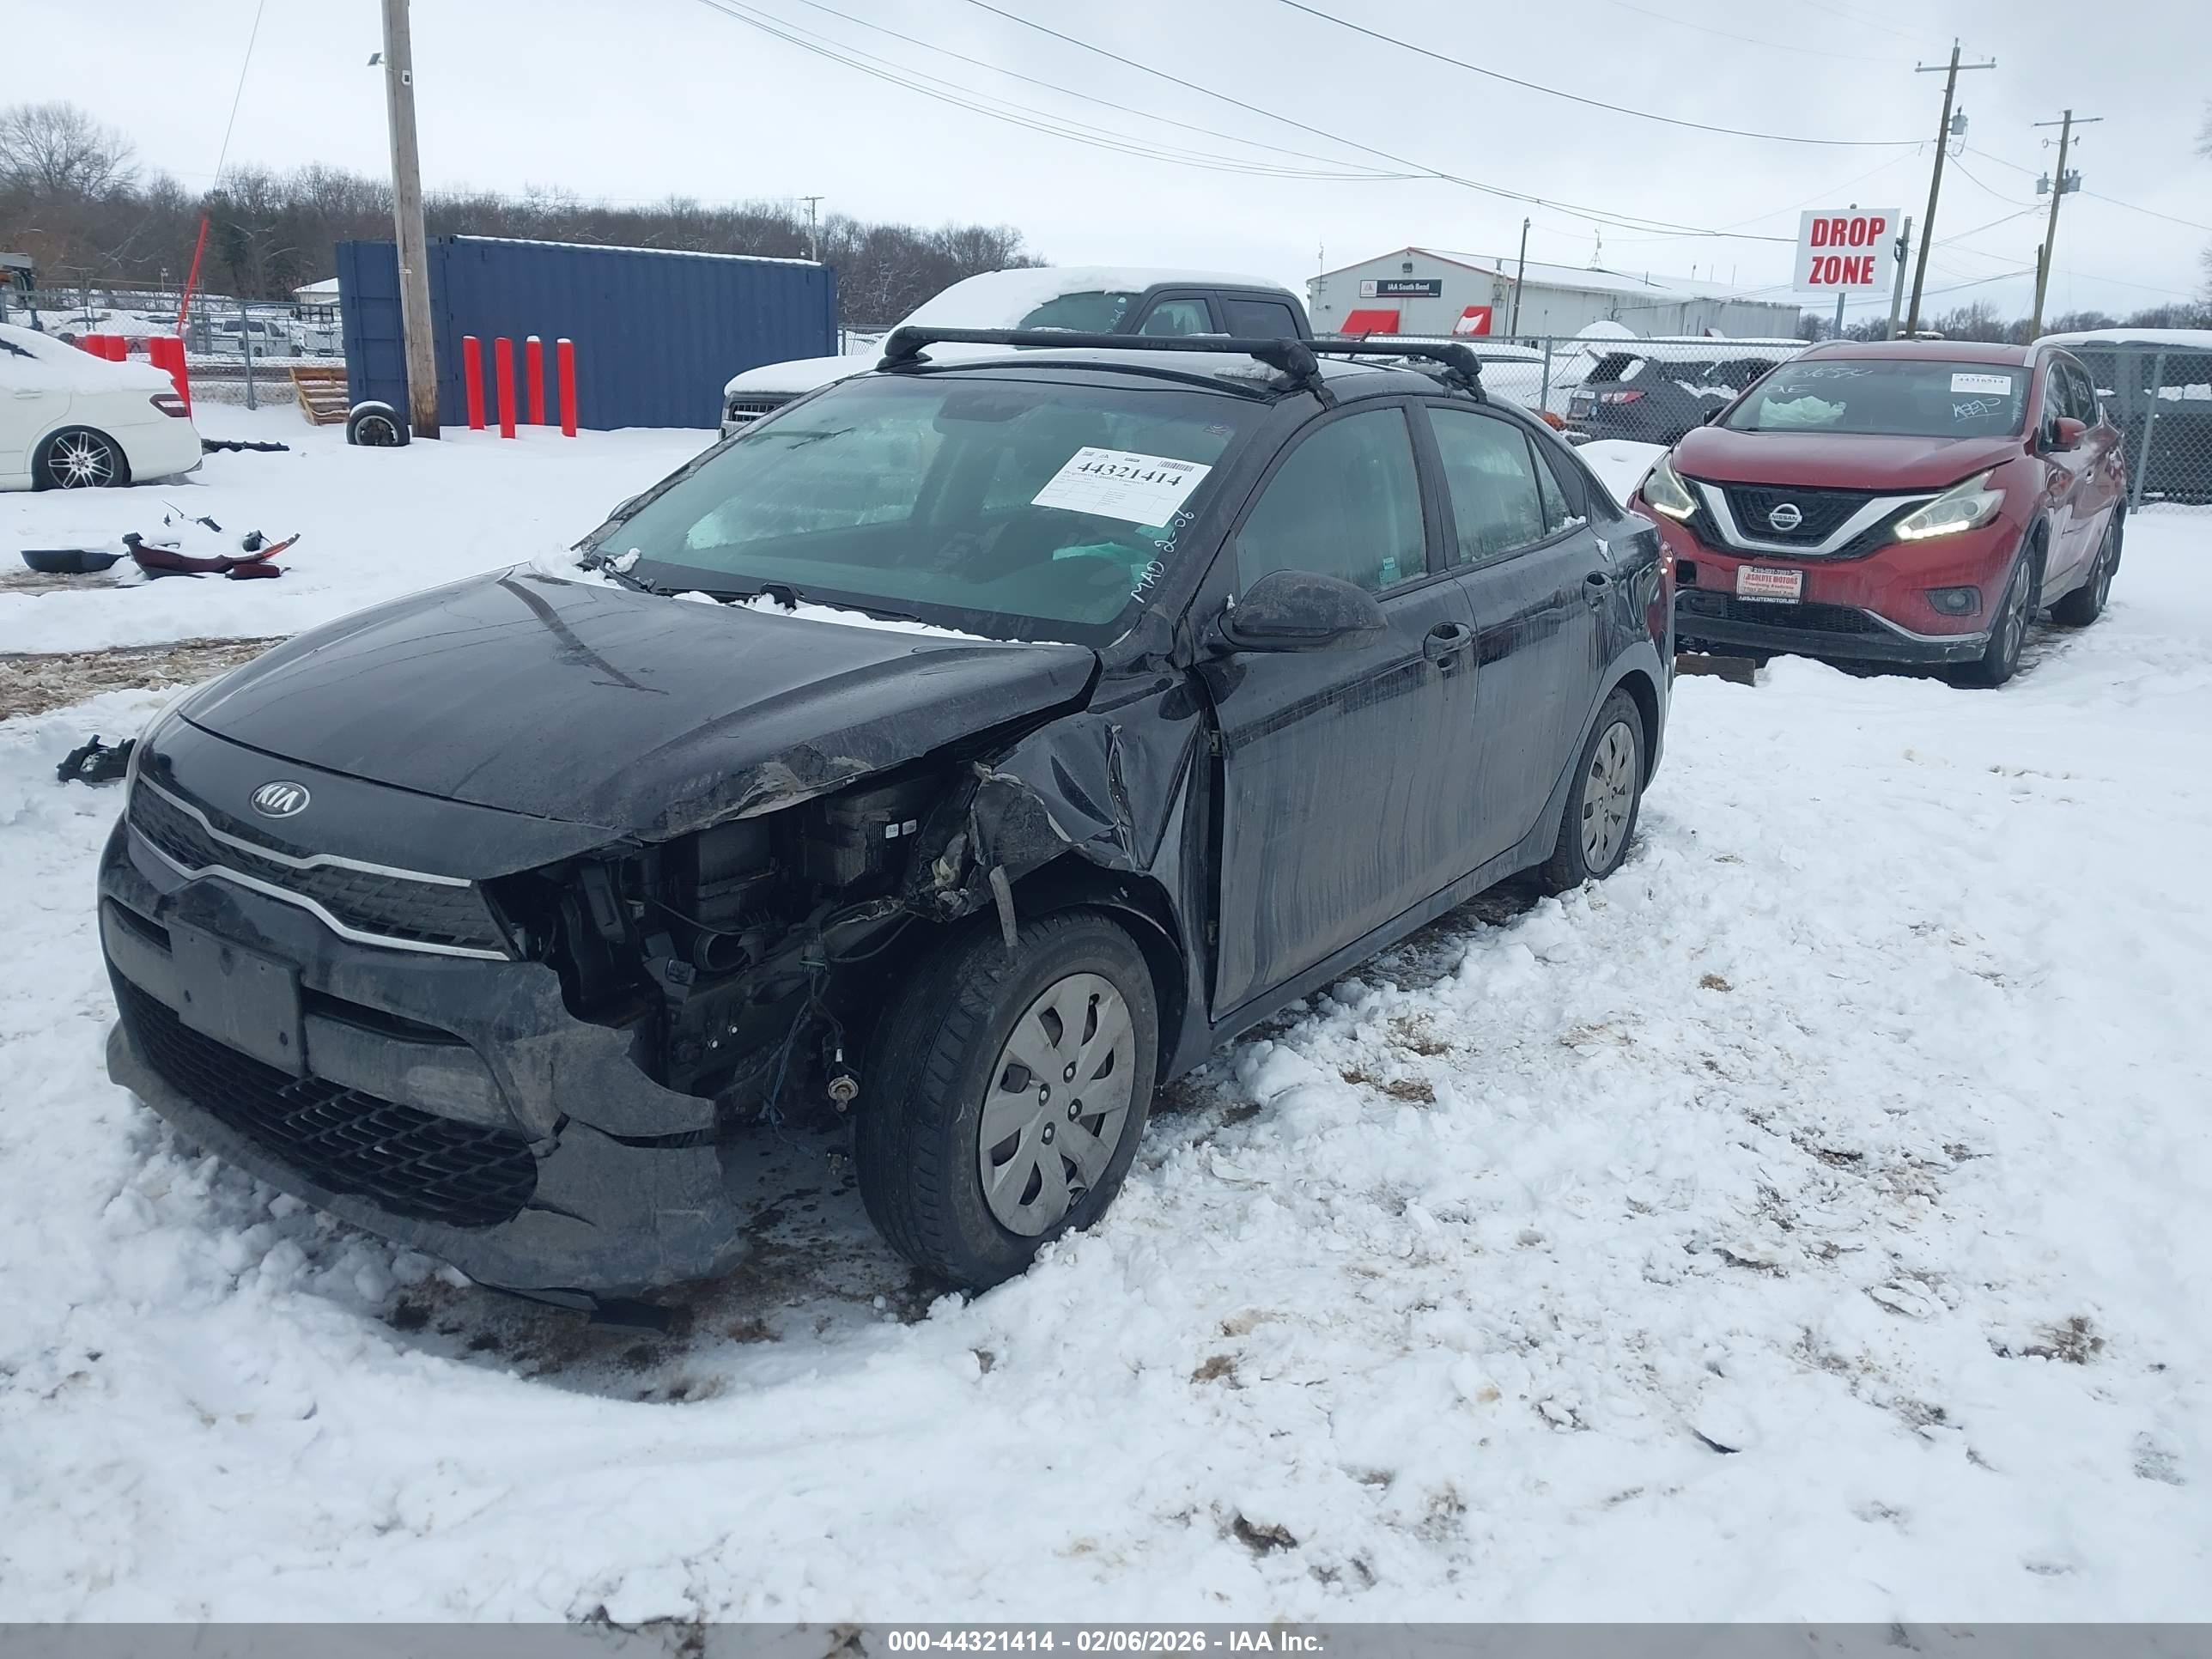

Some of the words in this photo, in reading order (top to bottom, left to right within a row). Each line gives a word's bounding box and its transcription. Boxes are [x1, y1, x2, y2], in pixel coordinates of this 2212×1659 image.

[1810, 217, 1886, 246] DROP
[1808, 256, 1876, 284] ZONE
[1077, 461, 1183, 487] 44321414
[1130, 560, 1164, 604] MAD
[1773, 576, 1798, 585] MOTORS
[253, 783, 299, 812] KIA
